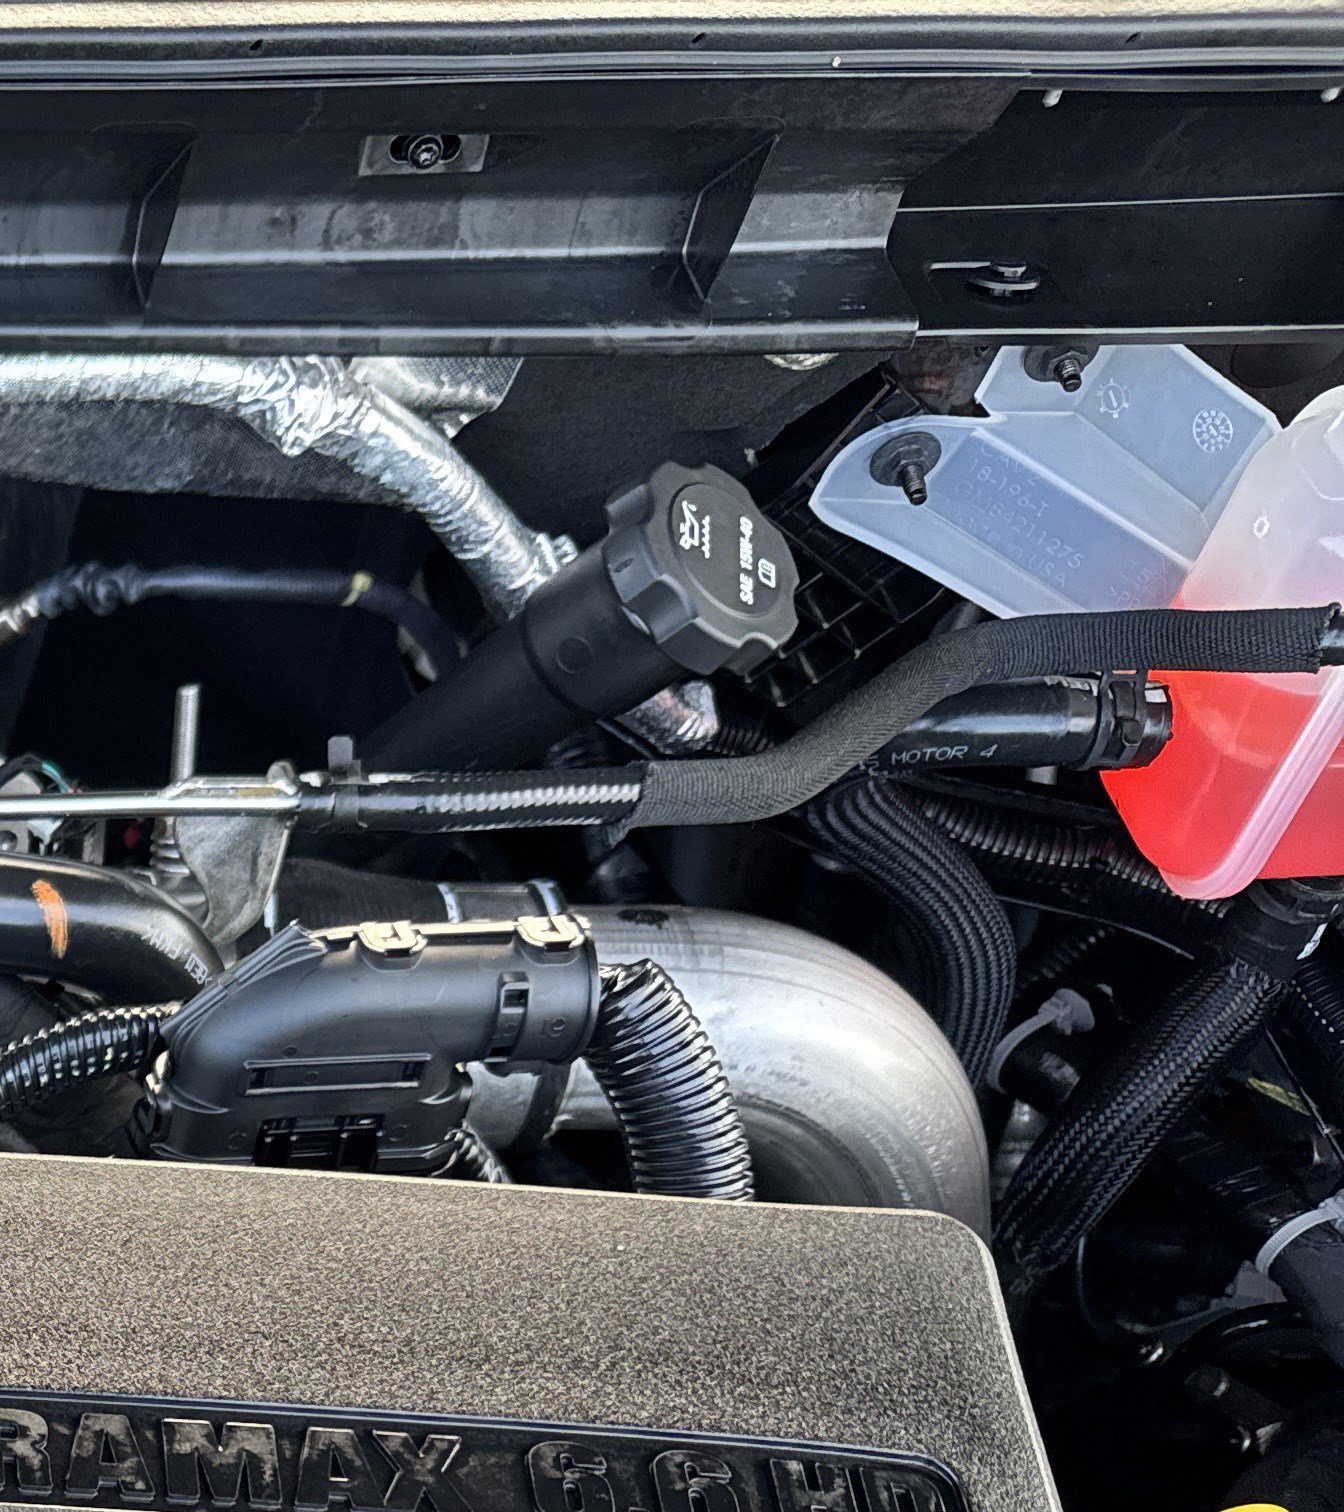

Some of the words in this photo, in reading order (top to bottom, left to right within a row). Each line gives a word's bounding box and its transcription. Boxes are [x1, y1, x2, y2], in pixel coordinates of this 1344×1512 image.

[739, 572, 754, 605] SAE
[891, 745, 969, 765] MOTOR
[979, 743, 999, 759] 4
